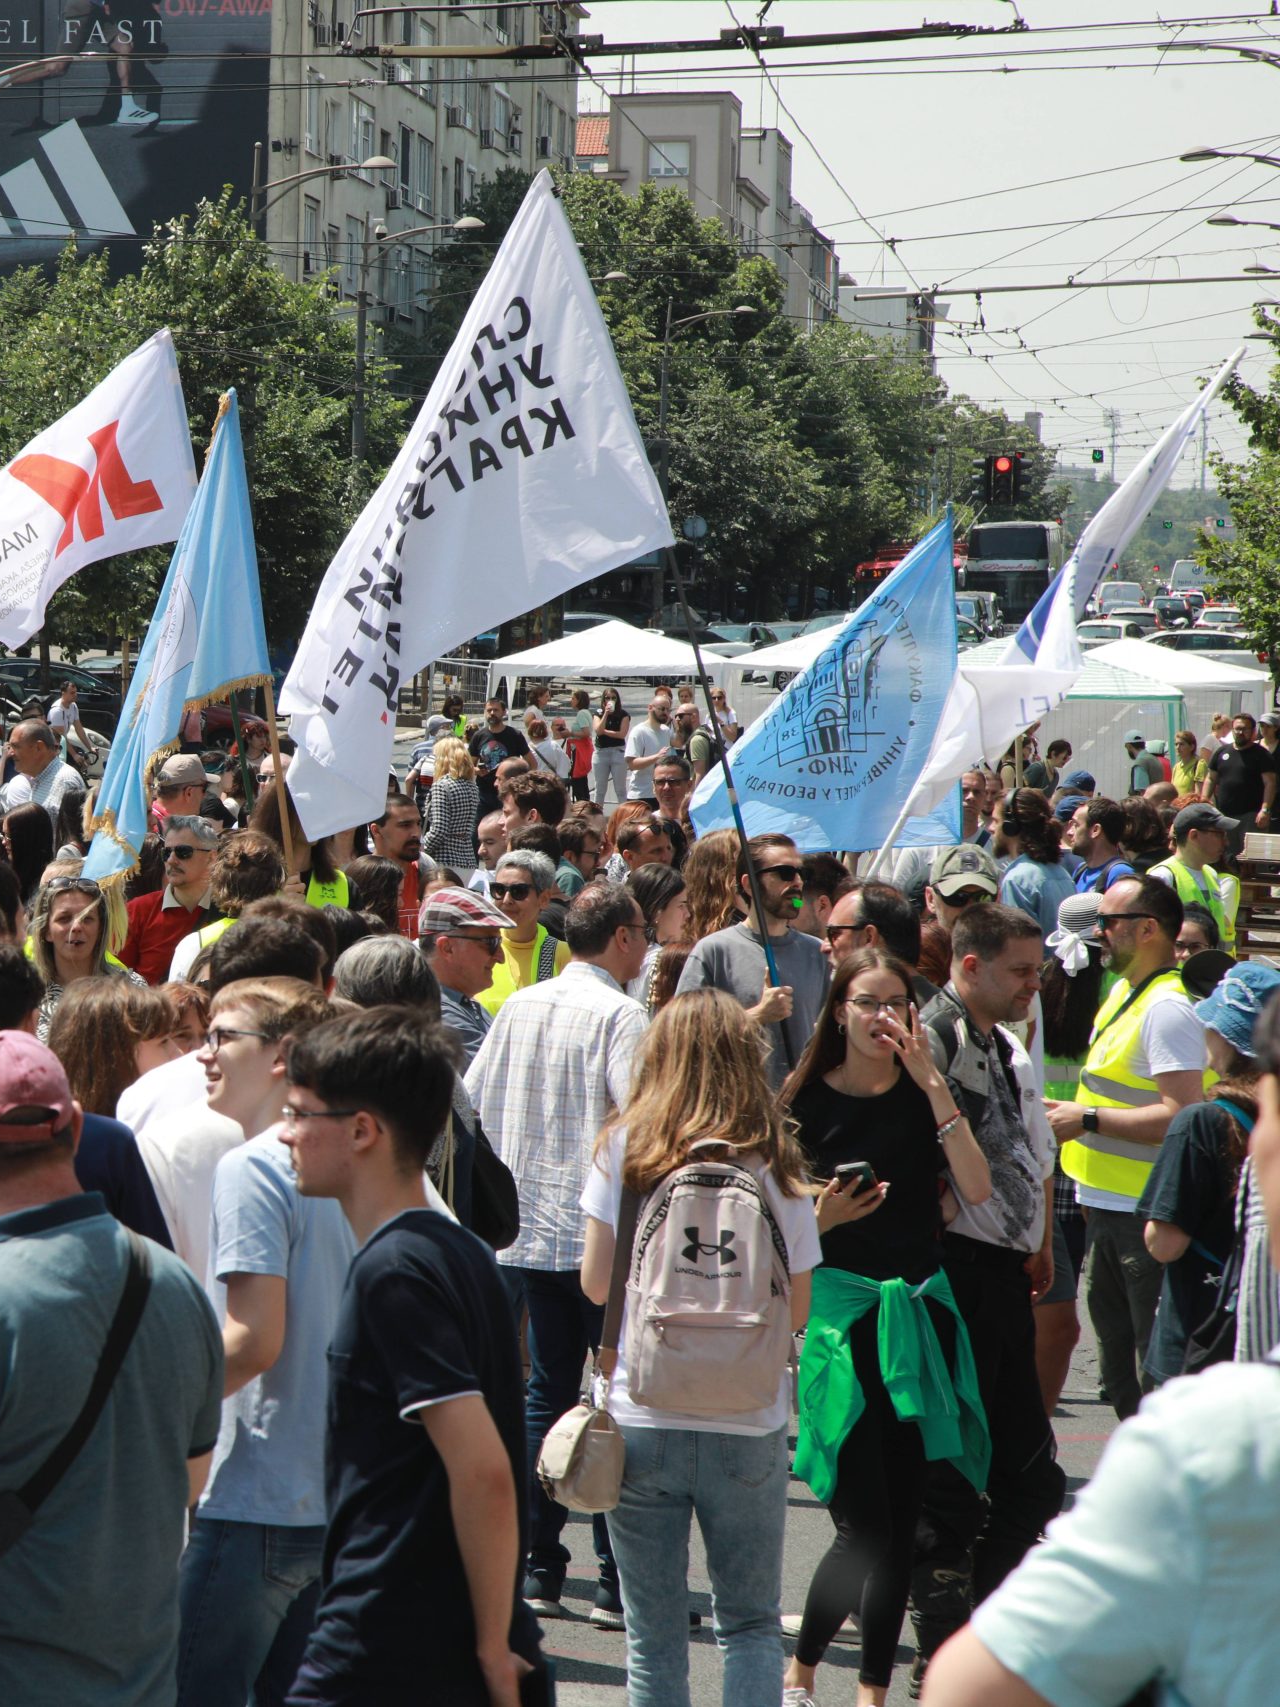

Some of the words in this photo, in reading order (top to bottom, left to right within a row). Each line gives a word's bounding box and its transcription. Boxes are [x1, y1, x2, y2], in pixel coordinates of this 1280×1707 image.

[63, 19, 163, 44] FAST
[674, 1267, 704, 1277] UNDER
[704, 1271, 742, 1280] ARMOUR
